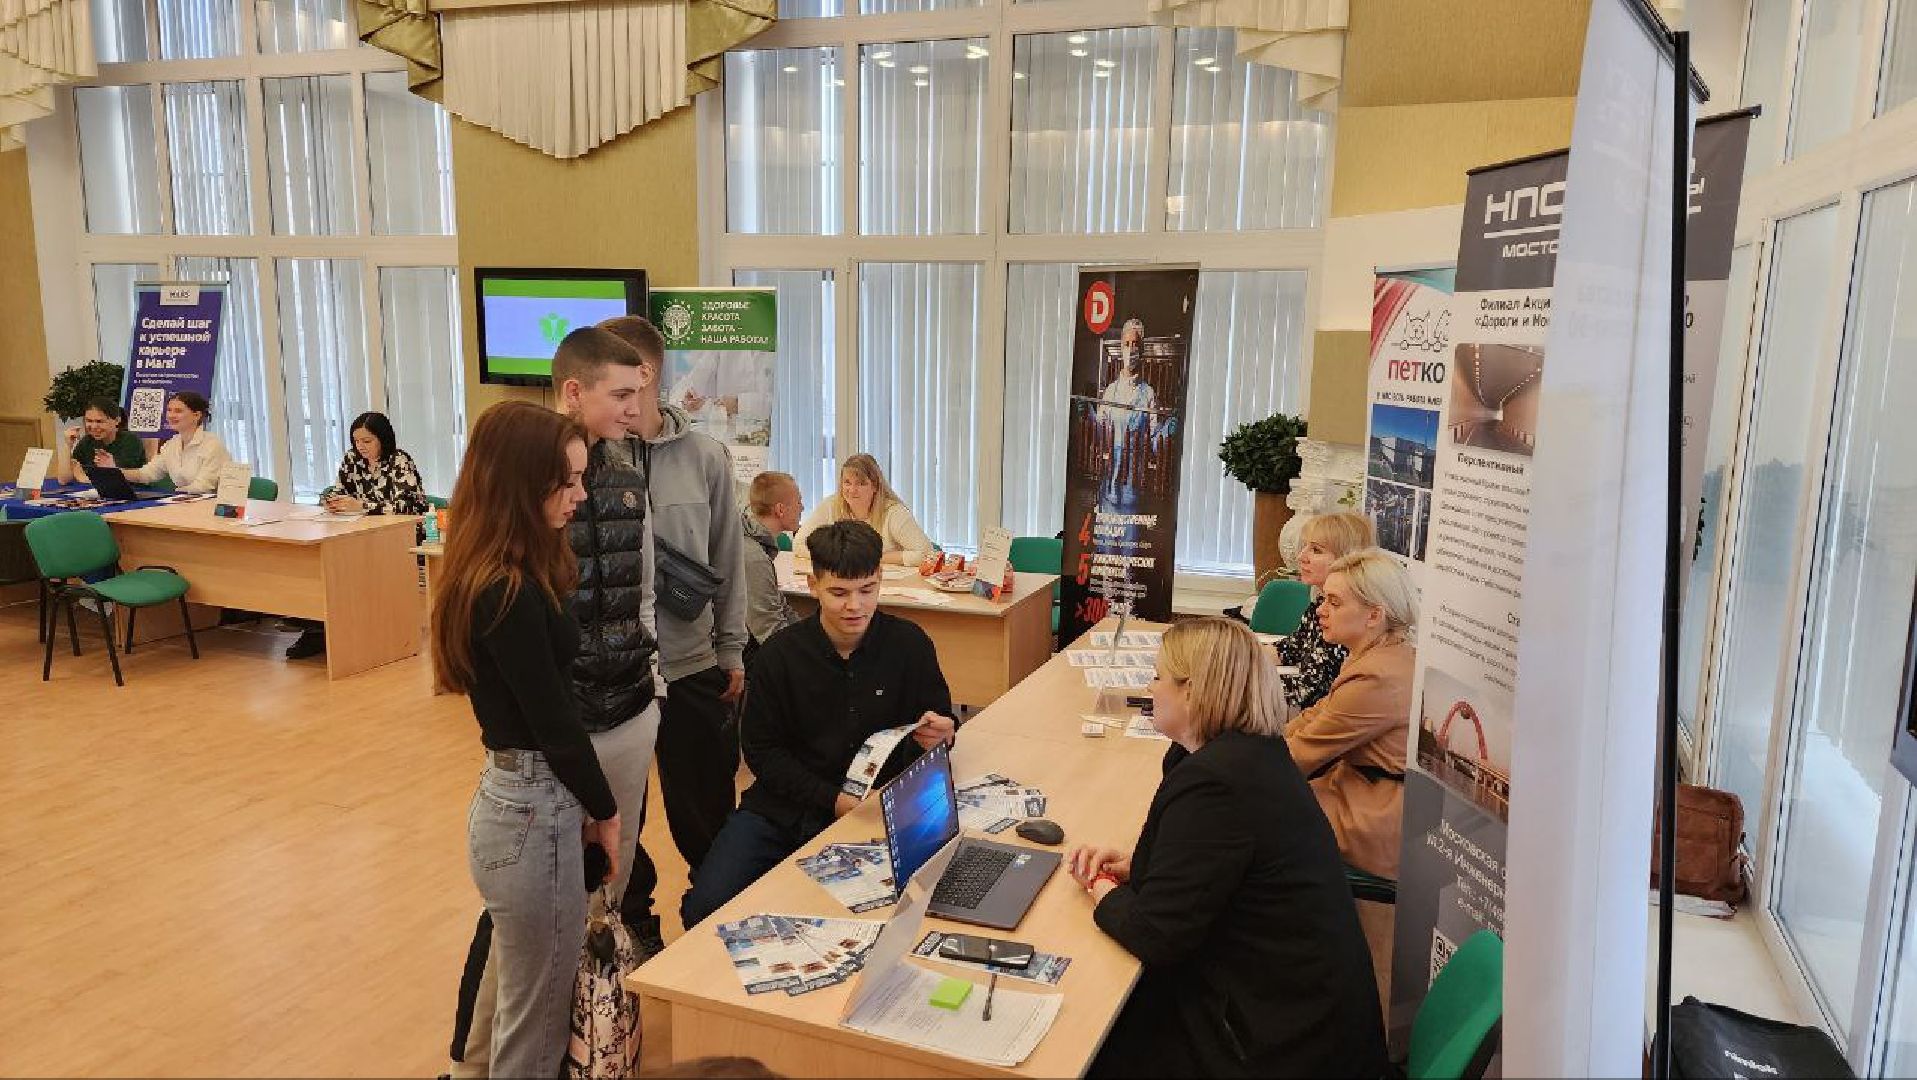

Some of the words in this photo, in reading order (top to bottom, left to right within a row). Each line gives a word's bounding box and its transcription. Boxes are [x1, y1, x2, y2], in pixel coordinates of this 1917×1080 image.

[1090, 291, 1110, 324] D
[1480, 298, 1520, 311] Филиал
[141, 316, 185, 329] Сделай
[187, 319, 212, 329] шаг
[701, 312, 740, 321] КРАСОТА
[1522, 316, 1530, 327] и
[148, 331, 211, 344] успешной
[701, 334, 728, 344] НАША
[138, 346, 187, 358] карьере
[1078, 512, 1093, 546] 4
[1076, 553, 1092, 586] 5
